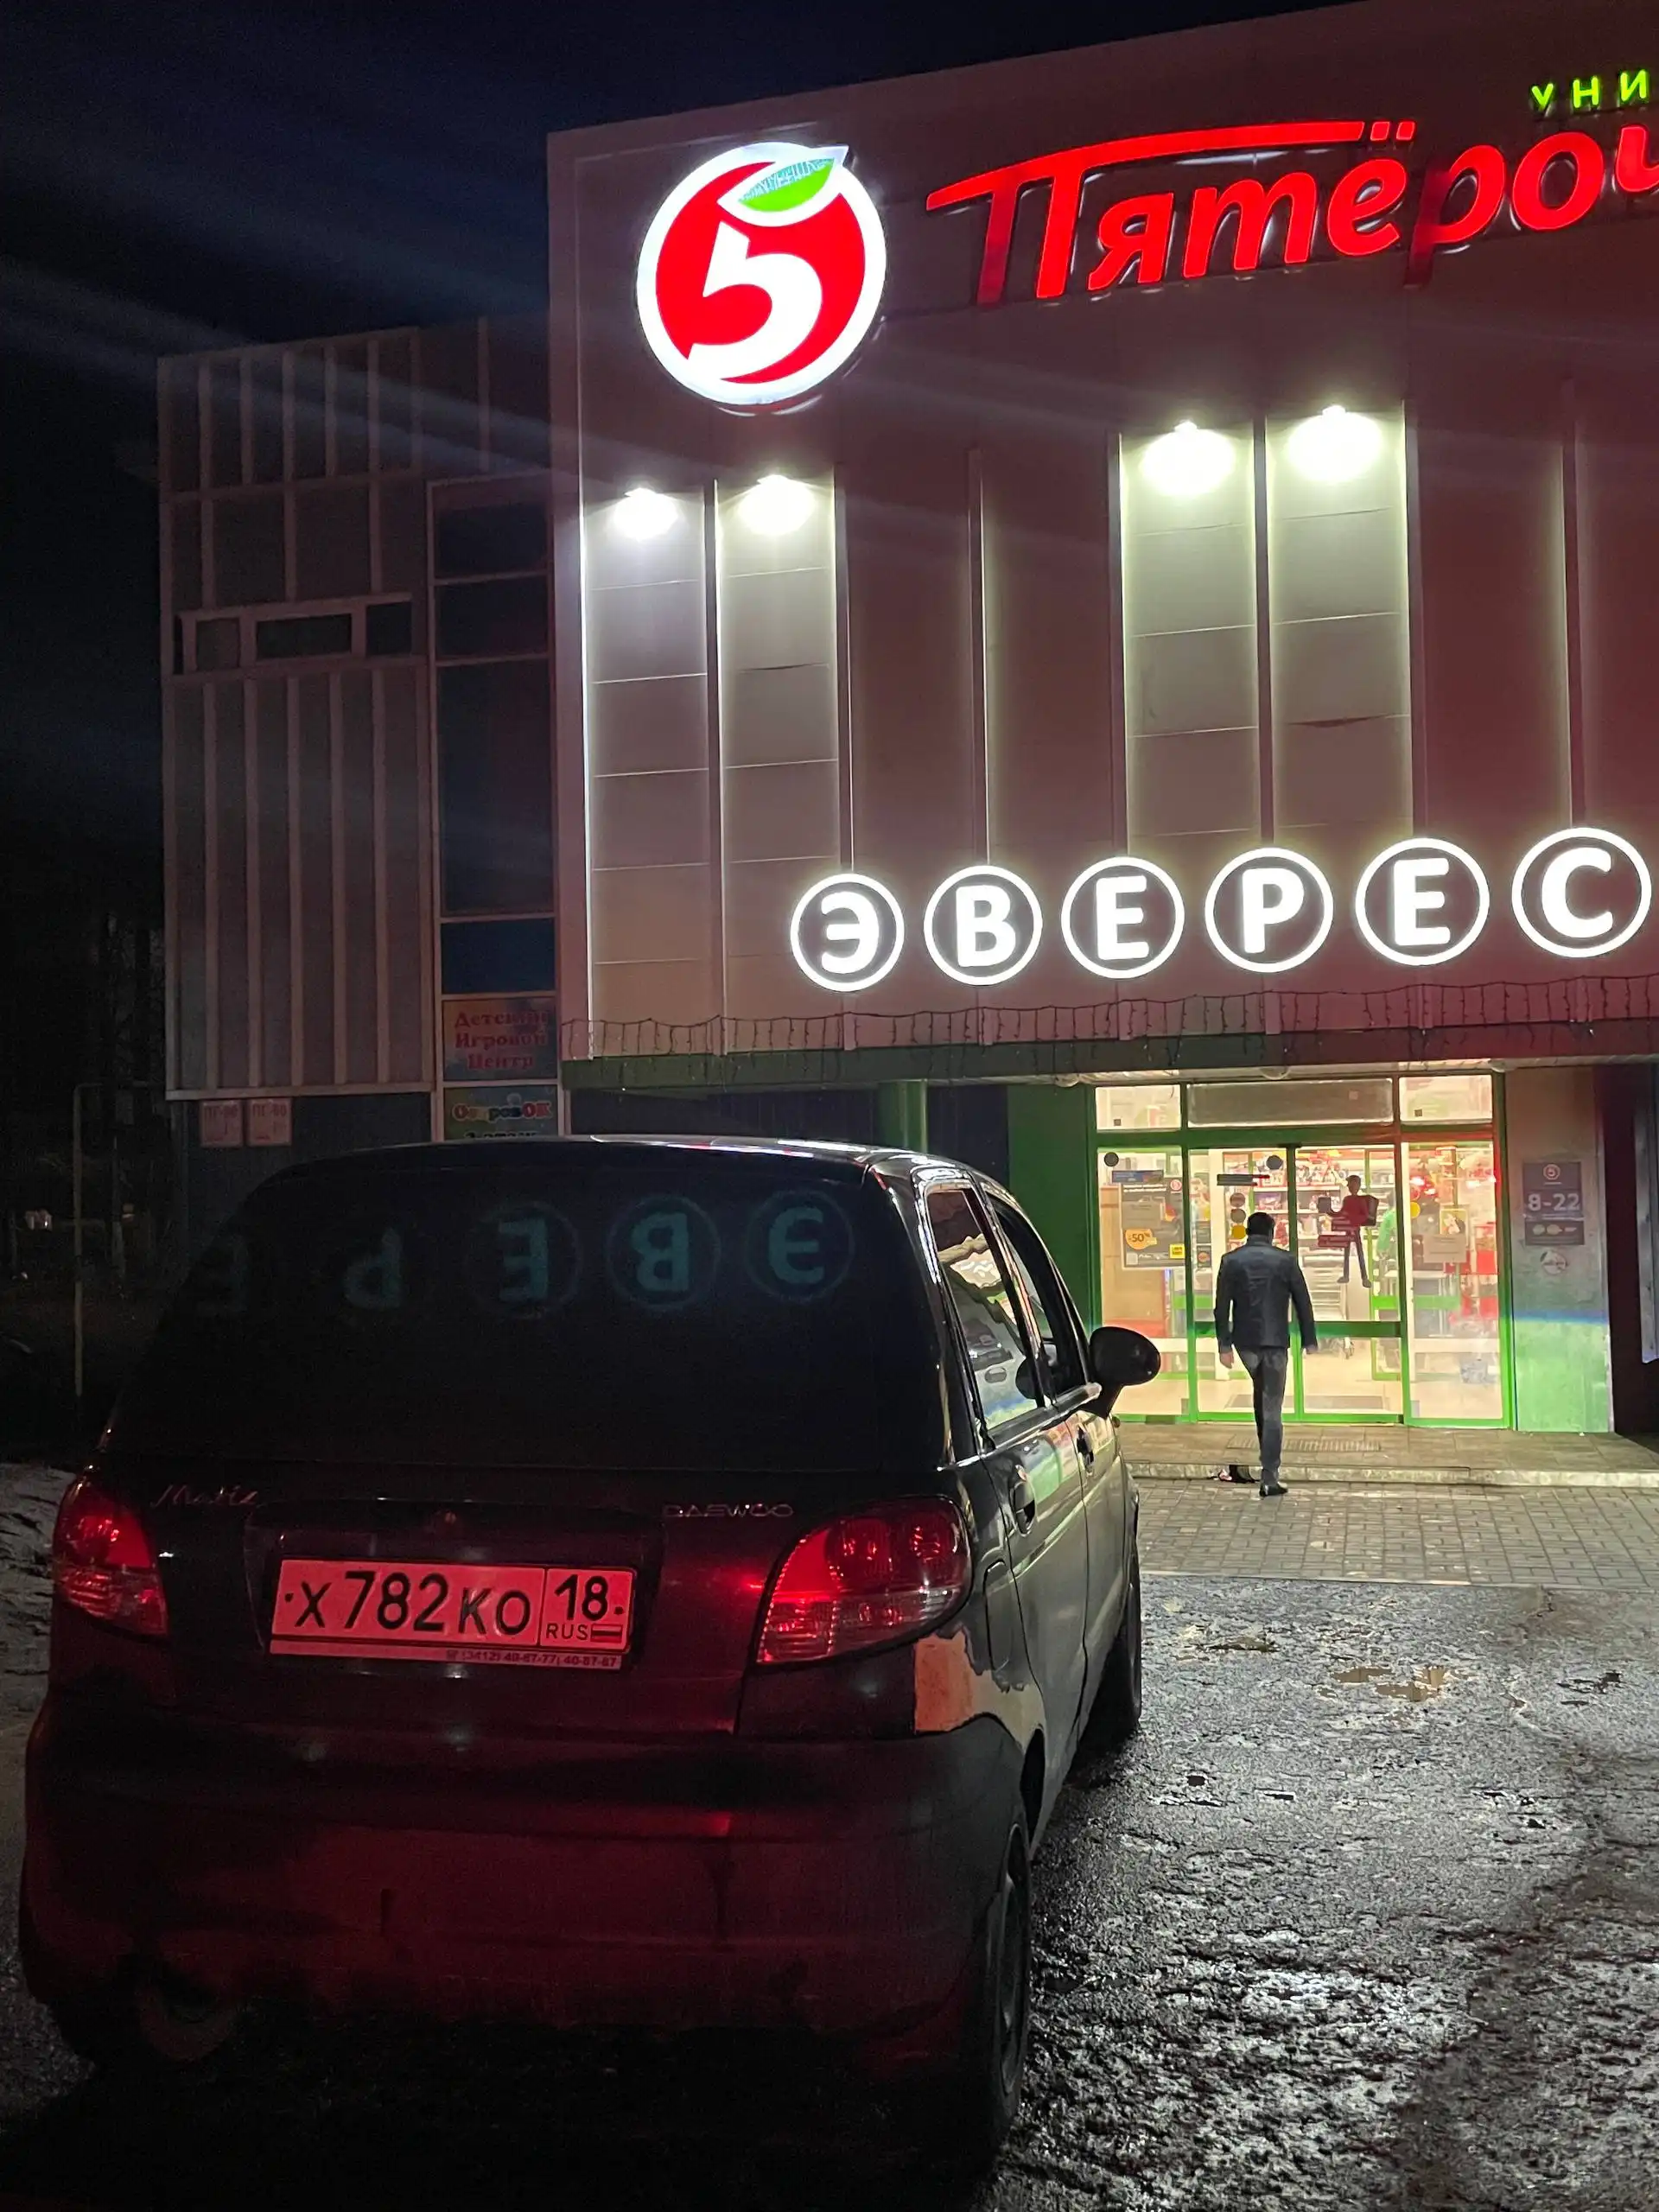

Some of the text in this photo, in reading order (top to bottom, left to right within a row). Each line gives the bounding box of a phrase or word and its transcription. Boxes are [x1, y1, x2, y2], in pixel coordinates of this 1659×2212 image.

[821, 849, 1613, 976] ЭВЕРЕС
[1528, 1192, 1580, 1212] 8-22
[661, 1503, 794, 1518] DAEWOO
[554, 1574, 608, 1621] 18
[546, 1623, 588, 1642] RUS
